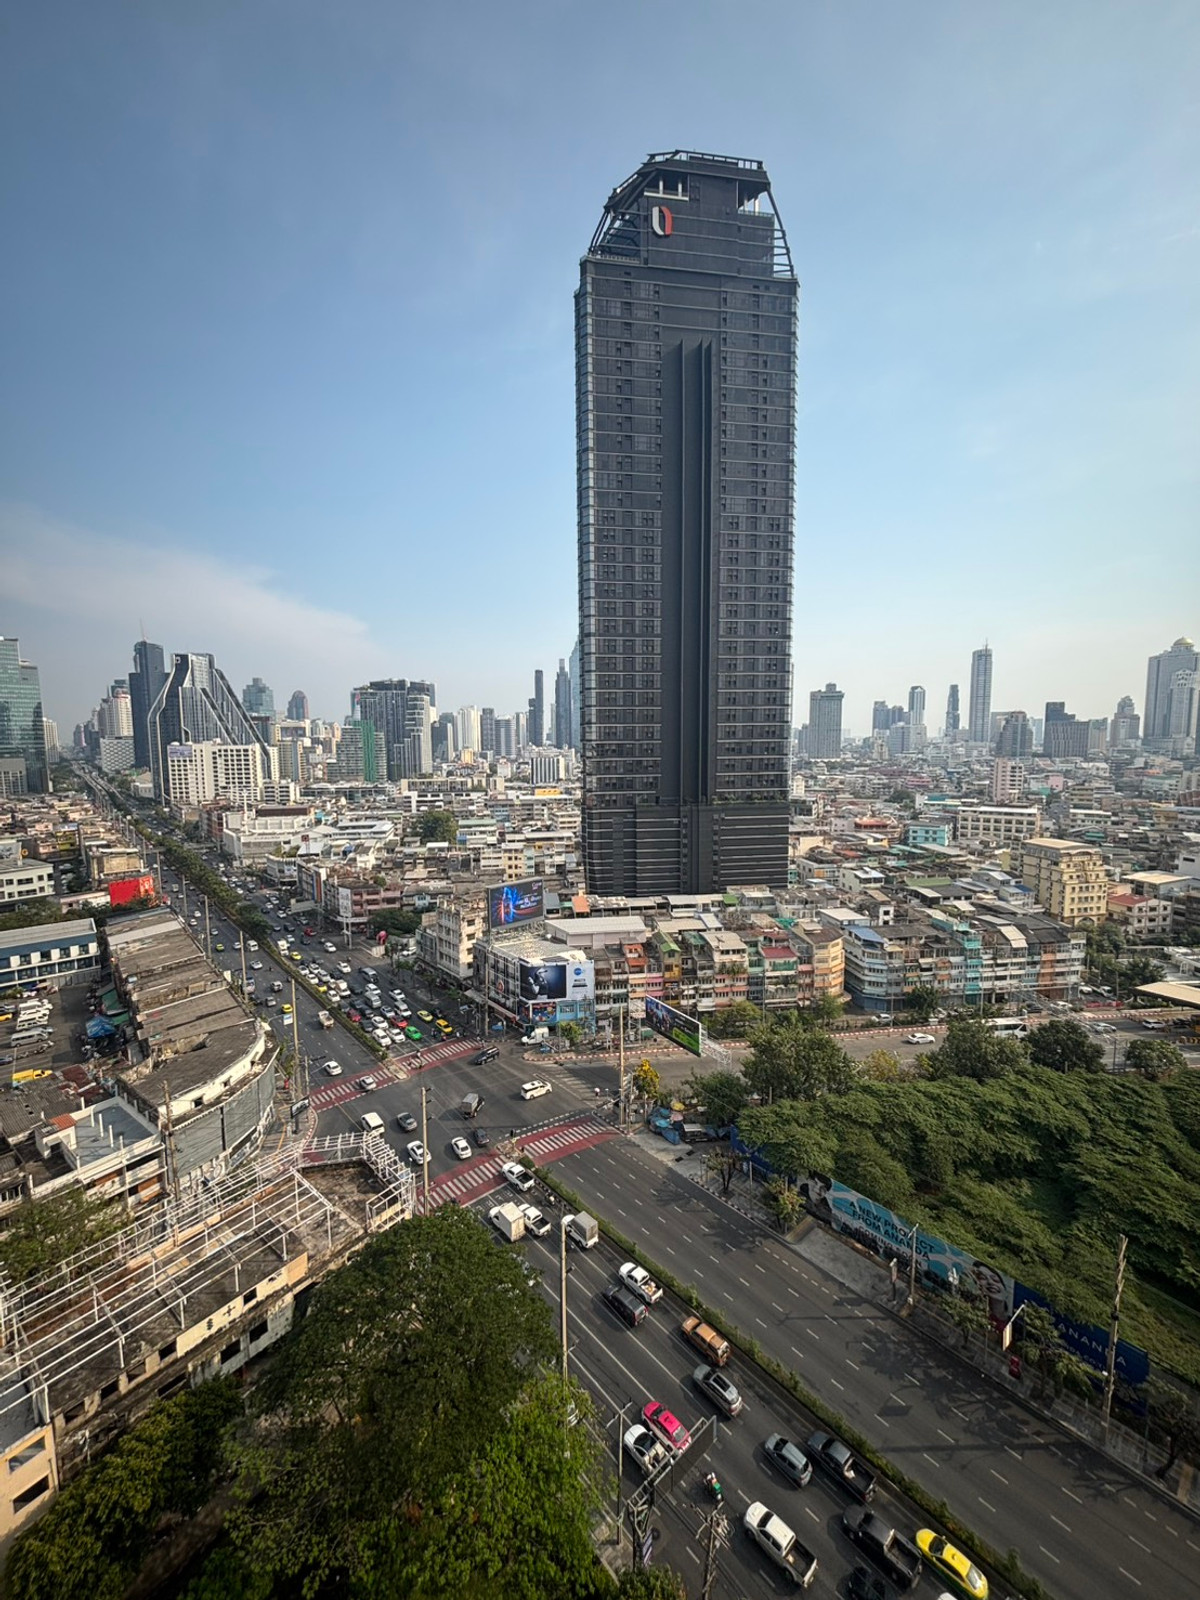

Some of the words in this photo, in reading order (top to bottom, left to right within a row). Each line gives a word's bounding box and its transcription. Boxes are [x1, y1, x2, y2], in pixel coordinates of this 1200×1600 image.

[852, 1210, 881, 1233] FROM
[858, 1206, 882, 1223] NEW
[884, 1219, 935, 1253] PROECT
